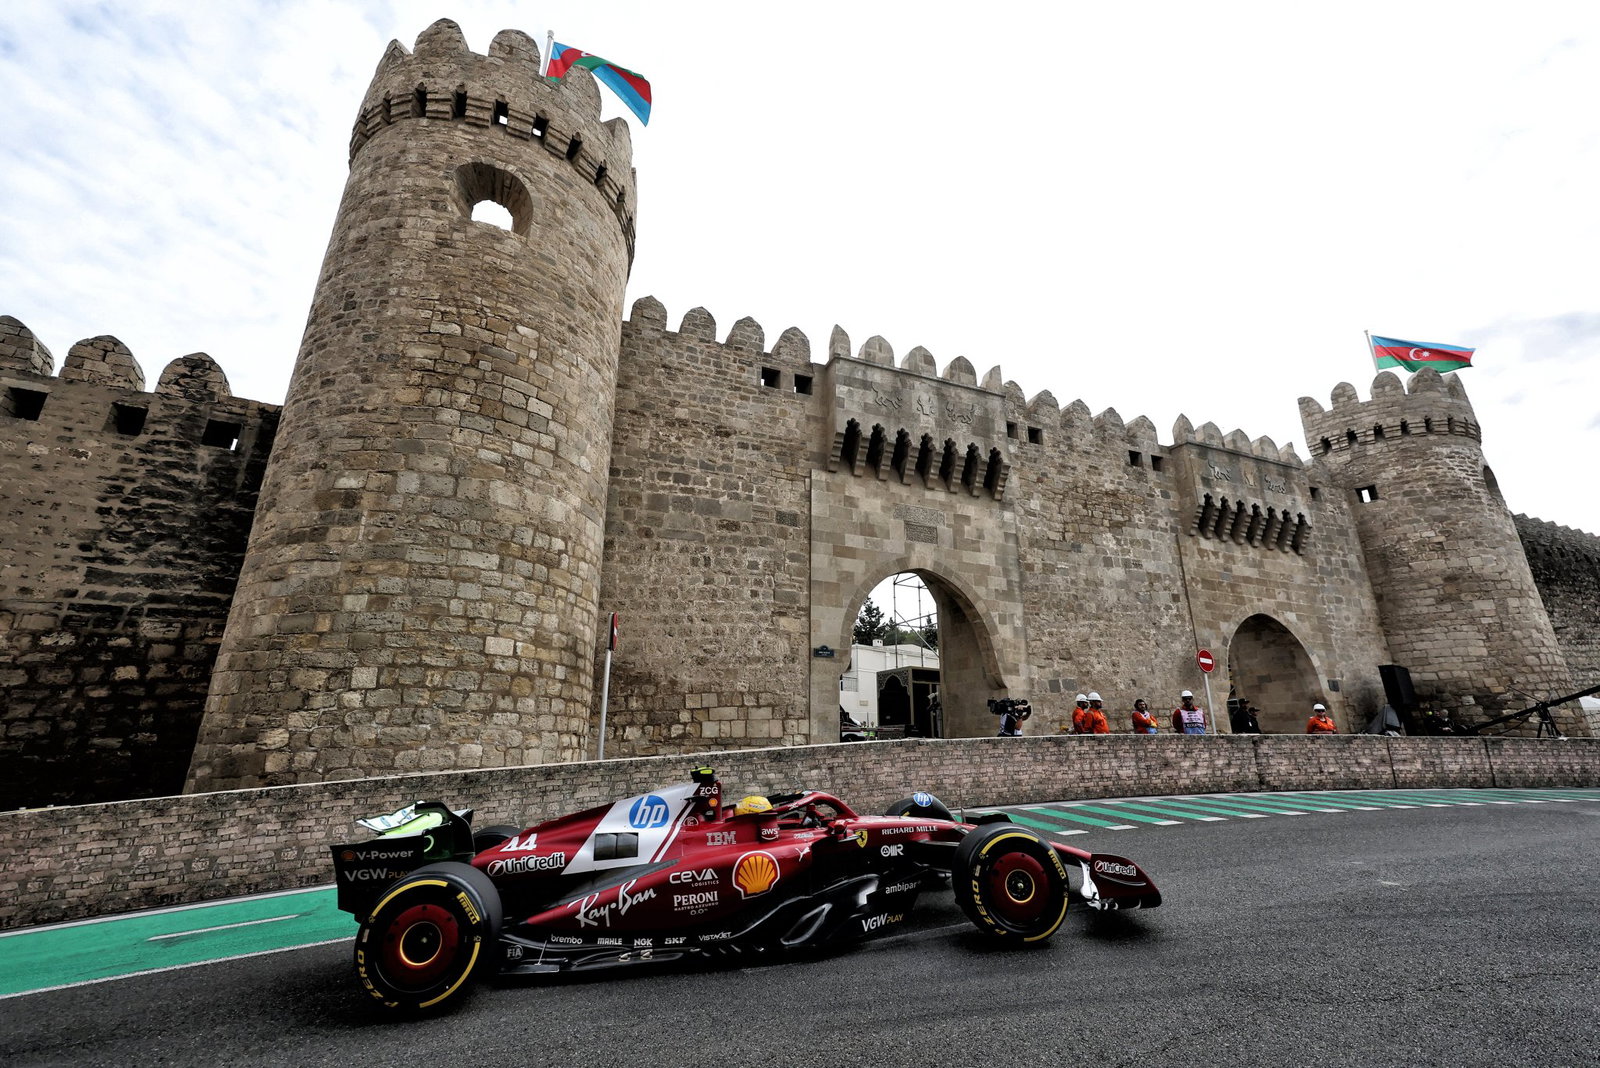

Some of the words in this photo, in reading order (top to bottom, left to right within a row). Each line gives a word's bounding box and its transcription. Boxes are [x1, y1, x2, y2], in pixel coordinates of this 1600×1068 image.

[632, 796, 666, 828] hp
[761, 828, 779, 836] aws
[881, 826, 915, 835] RICHARD
[500, 833, 538, 852] 44
[706, 831, 737, 846] IBM
[356, 850, 414, 861] V-Power
[504, 852, 565, 874] UniCredit
[344, 868, 388, 882] VGW
[1103, 861, 1137, 876] UniCredit
[885, 882, 918, 894] ambipar
[673, 891, 719, 906] PERONI
[456, 891, 480, 925] PIRELLI
[861, 912, 888, 932] VGW
[887, 913, 904, 924] PLAY
[550, 931, 583, 945] brembo
[634, 938, 653, 947] NGK
